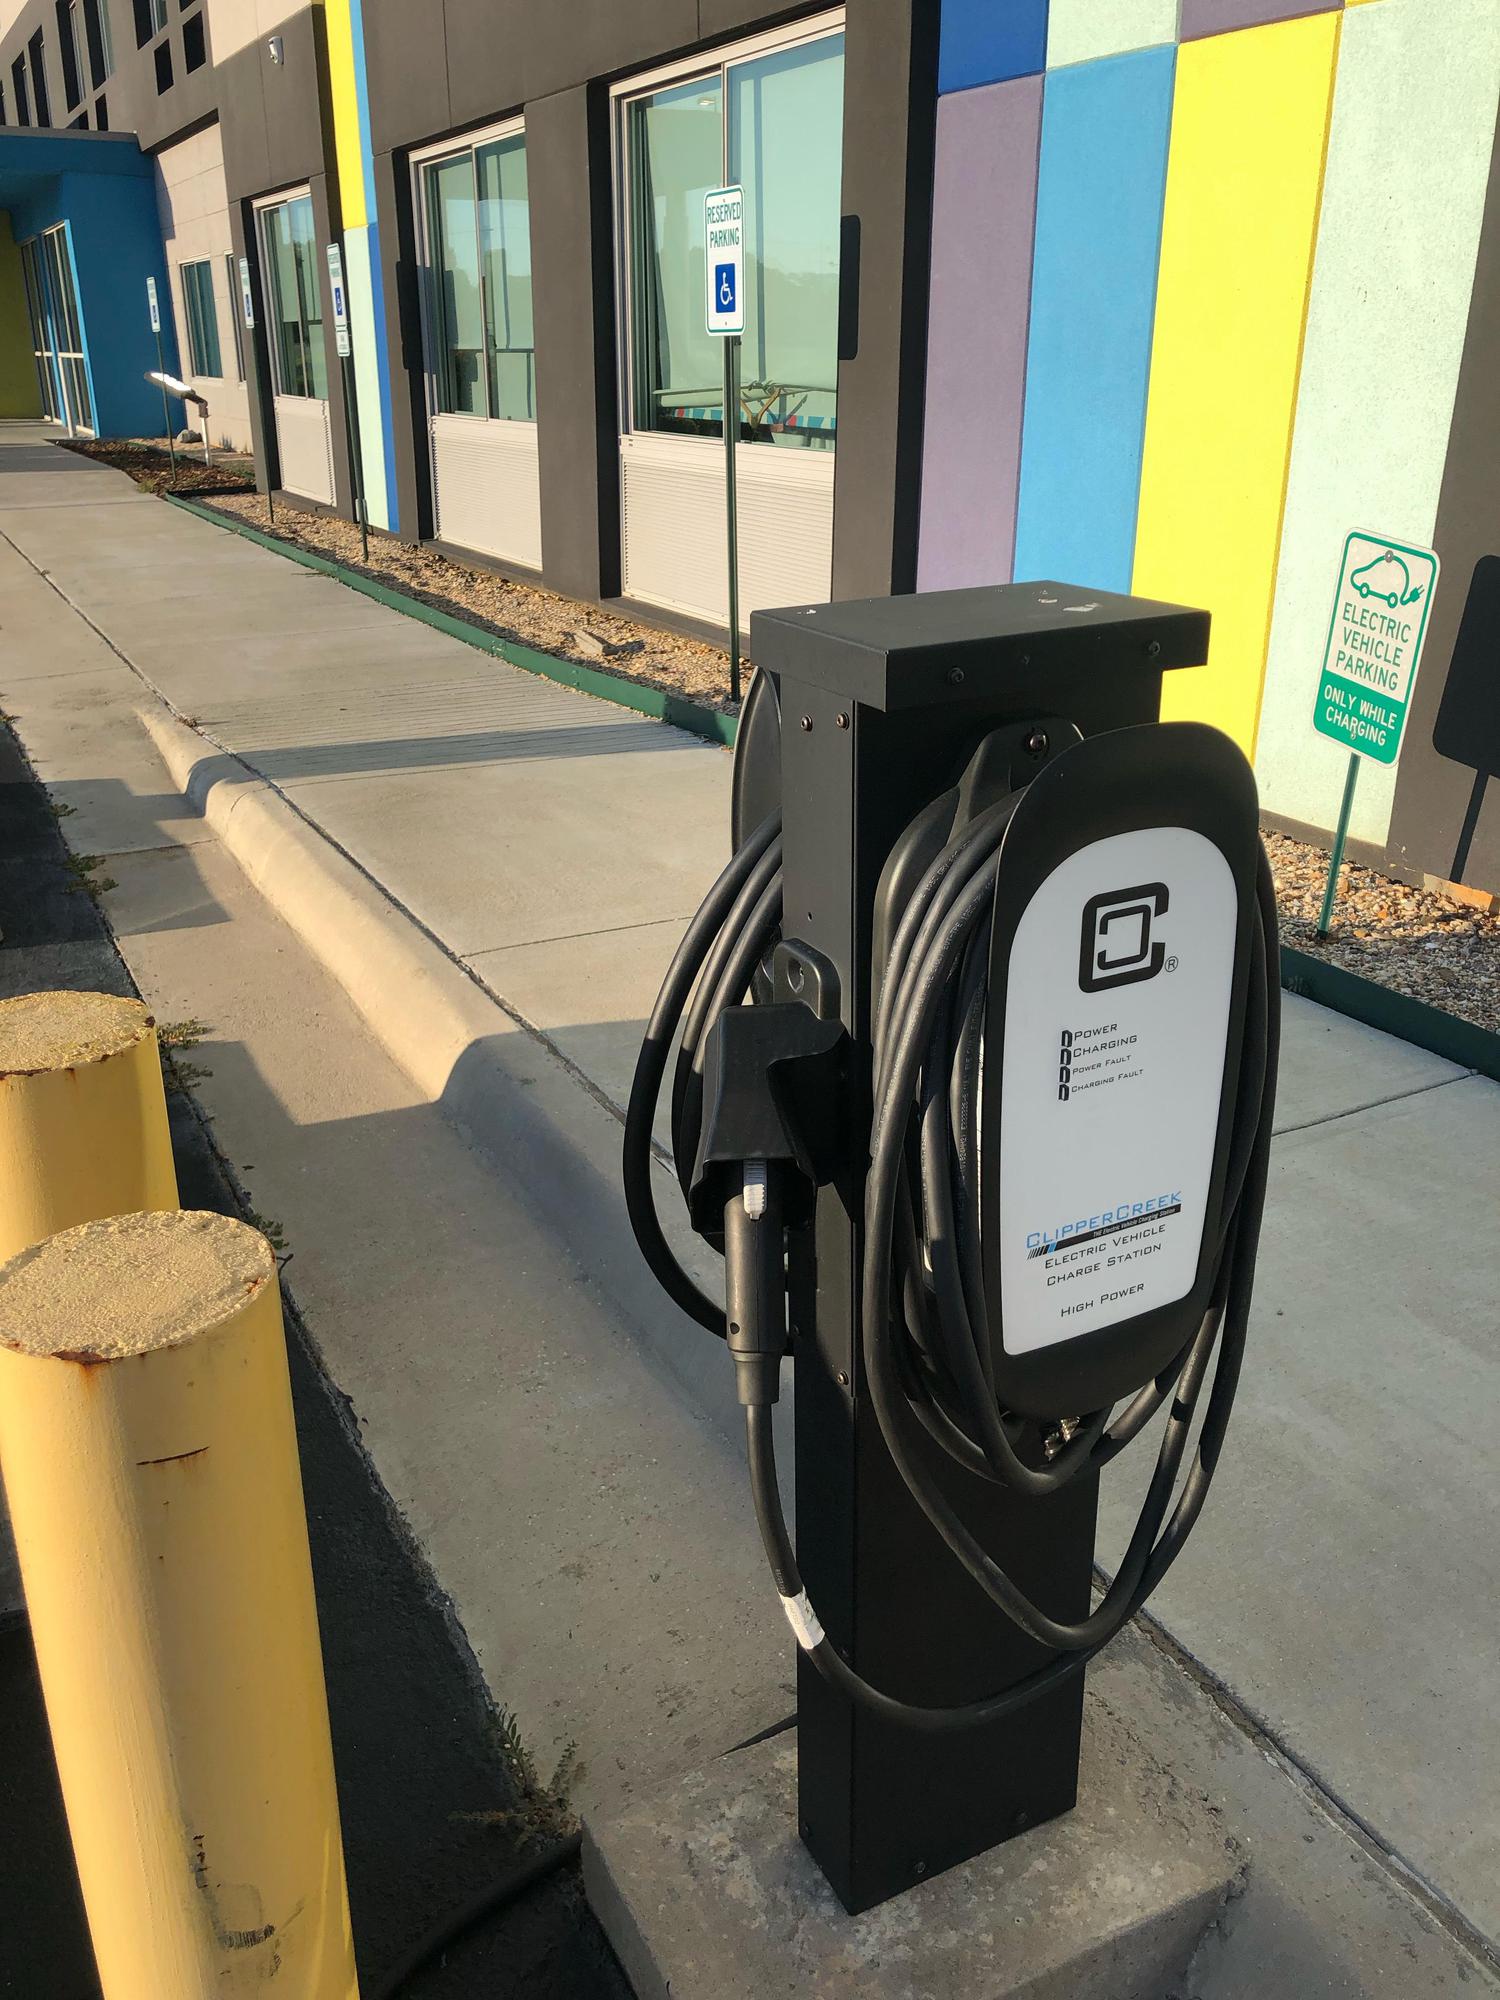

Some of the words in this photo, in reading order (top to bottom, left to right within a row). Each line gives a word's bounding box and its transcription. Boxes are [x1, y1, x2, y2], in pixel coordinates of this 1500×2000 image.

[707, 202, 741, 224] RESERVED
[710, 227, 739, 248] PARKING
[1342, 602, 1411, 643] ELECTRIC
[1344, 627, 1403, 667] VEHICLE
[1336, 650, 1399, 691] PARKING
[1324, 685, 1357, 710] ONLY
[1360, 699, 1397, 730] WHILE
[1326, 706, 1386, 746] CHARGING
[1073, 1034, 1138, 1058] CHARGING
[1074, 1023, 1118, 1041] POWER
[1071, 1076, 1114, 1093] CHARGING
[1118, 1068, 1144, 1080] FAULT
[1072, 1063, 1102, 1075] POWER
[1105, 1055, 1132, 1066] FAULT
[1045, 1243, 1107, 1269] ELECTRIC
[1113, 1224, 1166, 1246] VEHICLE
[1046, 1262, 1101, 1286] CHARGE
[1107, 1243, 1162, 1267] STATION
[1060, 1300, 1094, 1317] HIGH
[1100, 1283, 1145, 1304] POWER
